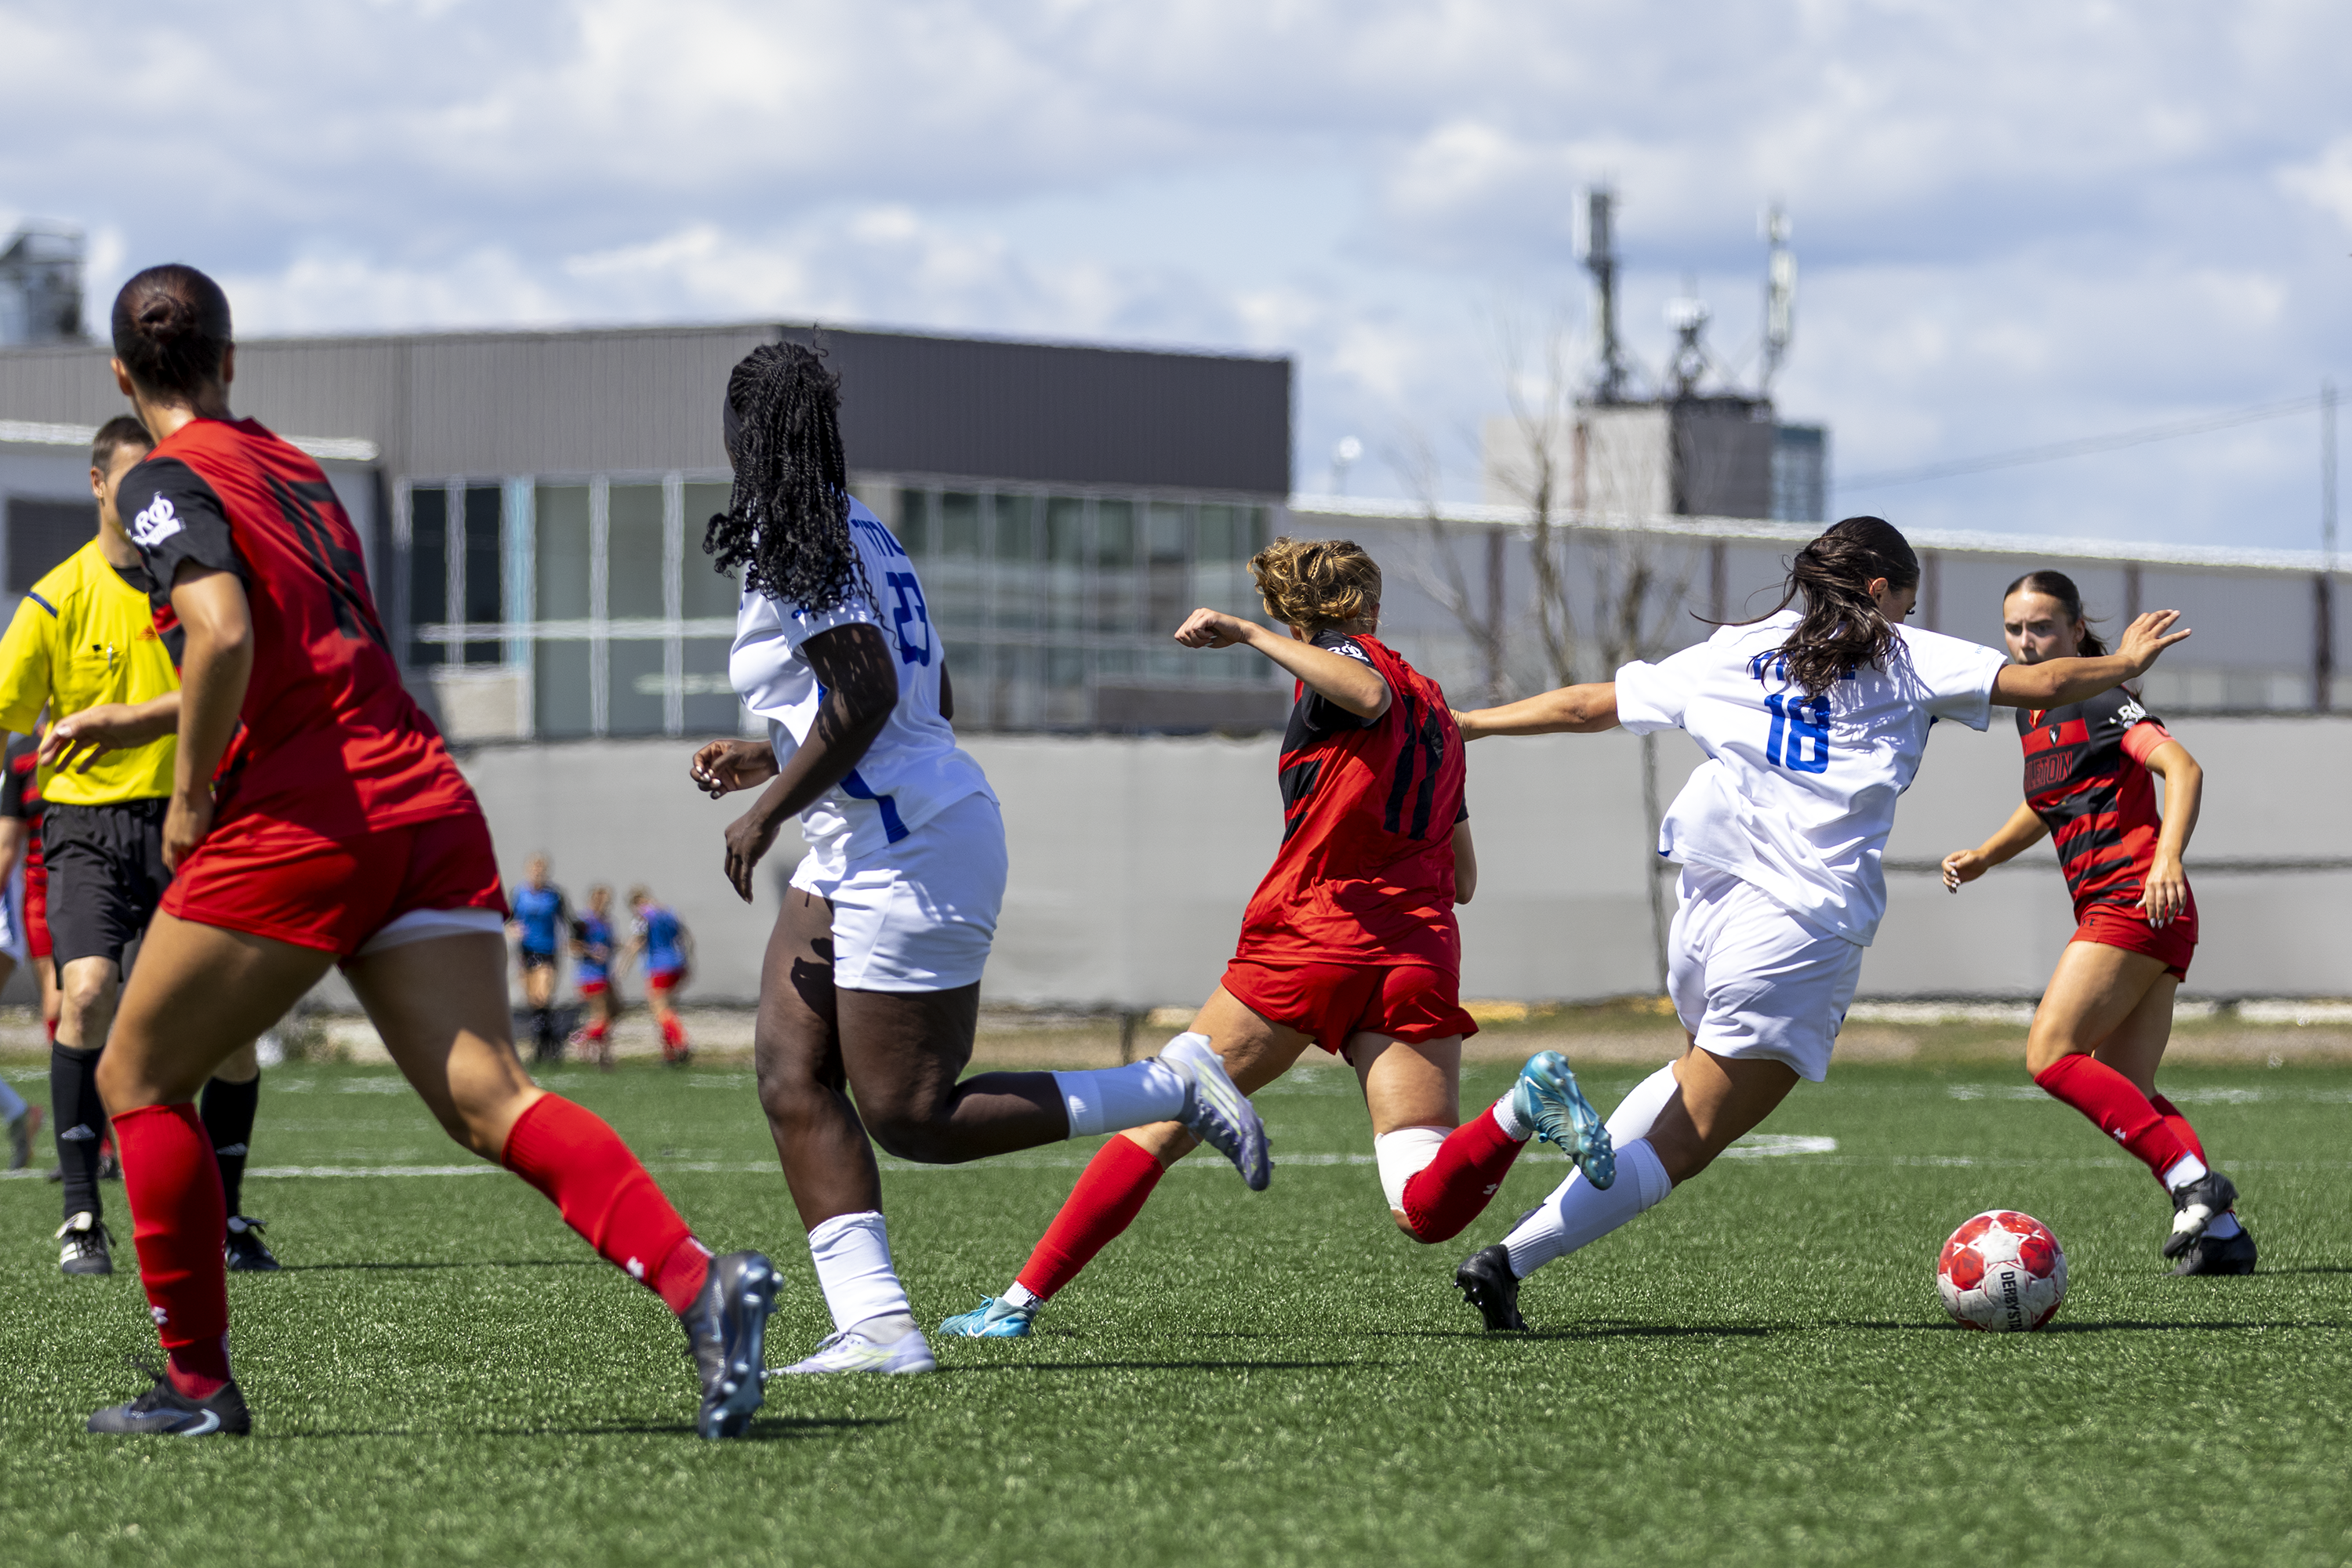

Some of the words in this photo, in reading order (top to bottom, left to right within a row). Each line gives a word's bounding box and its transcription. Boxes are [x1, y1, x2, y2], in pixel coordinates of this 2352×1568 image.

[886, 572, 930, 667] 23
[1382, 695, 1444, 841] 11
[1764, 693, 1831, 774] 18
